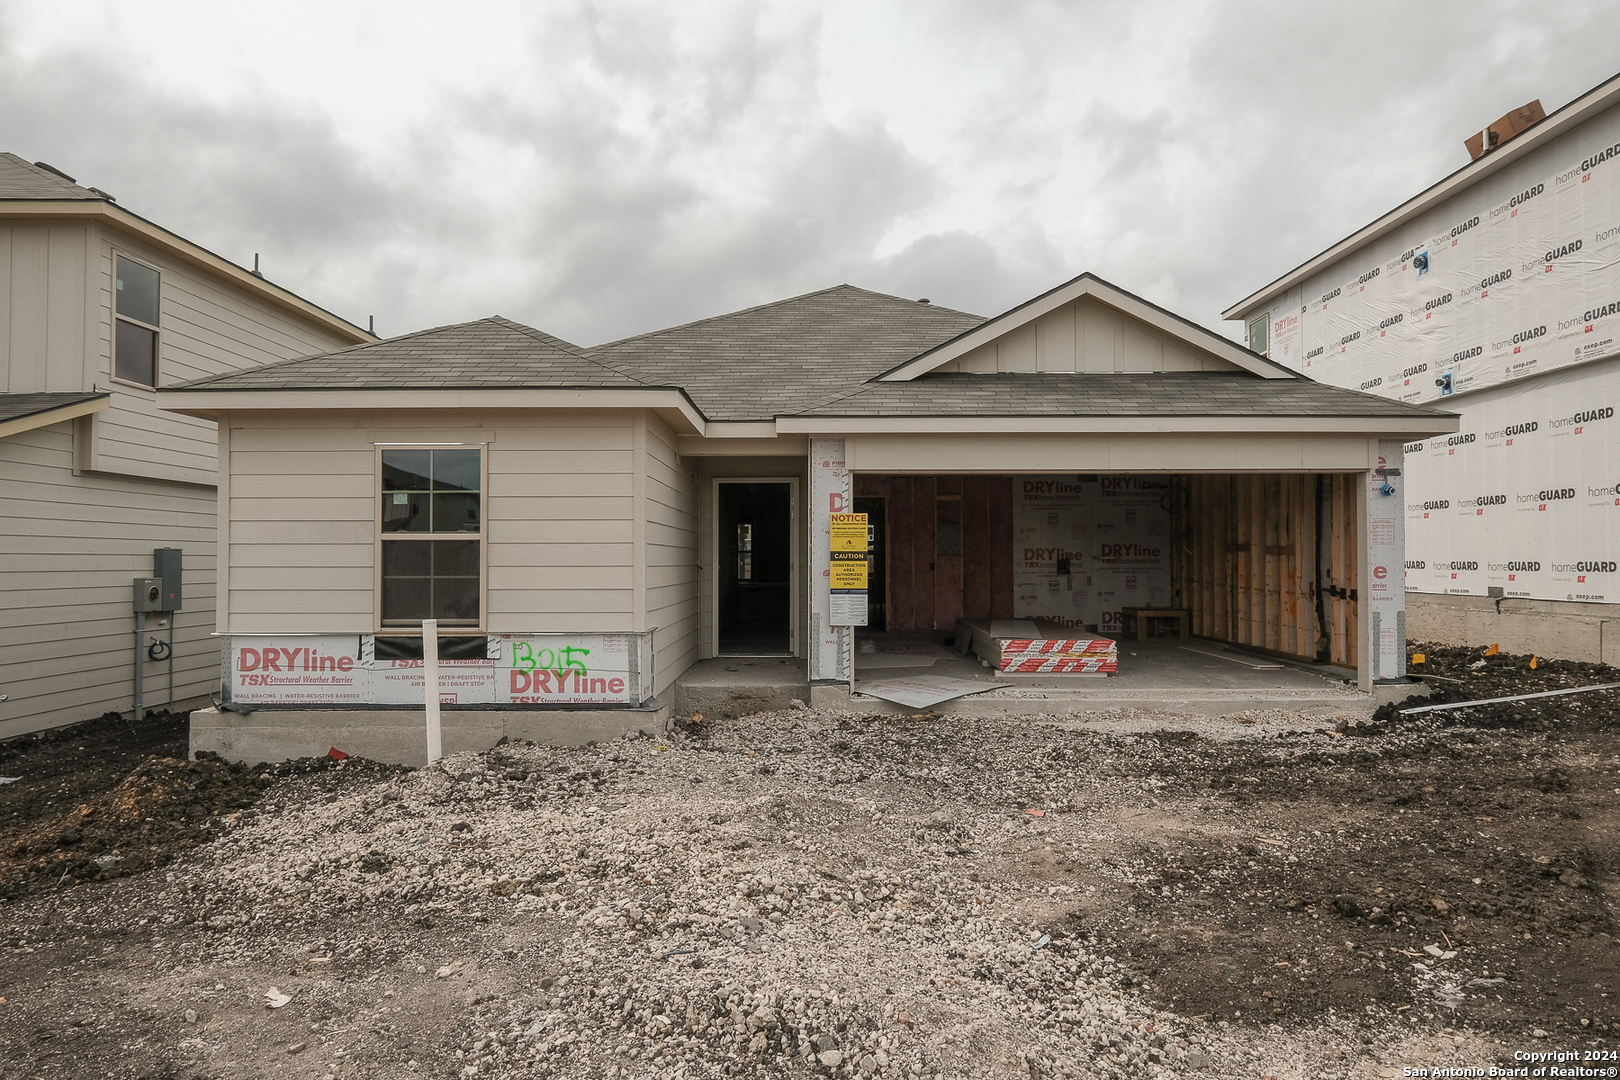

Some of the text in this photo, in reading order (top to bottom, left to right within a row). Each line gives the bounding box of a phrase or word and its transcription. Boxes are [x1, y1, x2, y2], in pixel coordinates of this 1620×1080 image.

[1489, 183, 1545, 219] homeGUARD
[1432, 216, 1480, 247] homeGUARD
[1522, 239, 1583, 272] homeGUARD
[1346, 267, 1380, 291] homeGUARD
[1460, 268, 1512, 296] homeGUARD
[1410, 293, 1453, 317] homeGUARD
[1274, 316, 1298, 333] DRYline
[1366, 313, 1403, 335] homeGUARD
[1491, 325, 1547, 351] homeGUARD
[1434, 345, 1483, 369] homeGUARD
[1388, 363, 1428, 382] homeGUARD
[1549, 406, 1615, 429] homeGUARD
[1485, 421, 1539, 440] homeGUARD
[1430, 433, 1476, 450] homeGUARD
[1023, 480, 1082, 493] DRYline
[1516, 487, 1576, 504] homeGUARD
[1407, 499, 1450, 512] homeGUARD
[1458, 494, 1507, 509] homeGUARD
[831, 514, 867, 522] NOTICE
[1024, 547, 1083, 561] DRYline
[1101, 543, 1160, 556] DRYline
[1432, 561, 1479, 571] homeGUARD
[1487, 561, 1541, 572] homeGUARD
[1551, 561, 1617, 573] homeGUARD
[240, 648, 354, 672] DRYline
[239, 674, 353, 686] TSX Structural Weather Barrier
[510, 669, 625, 694] DRYline
